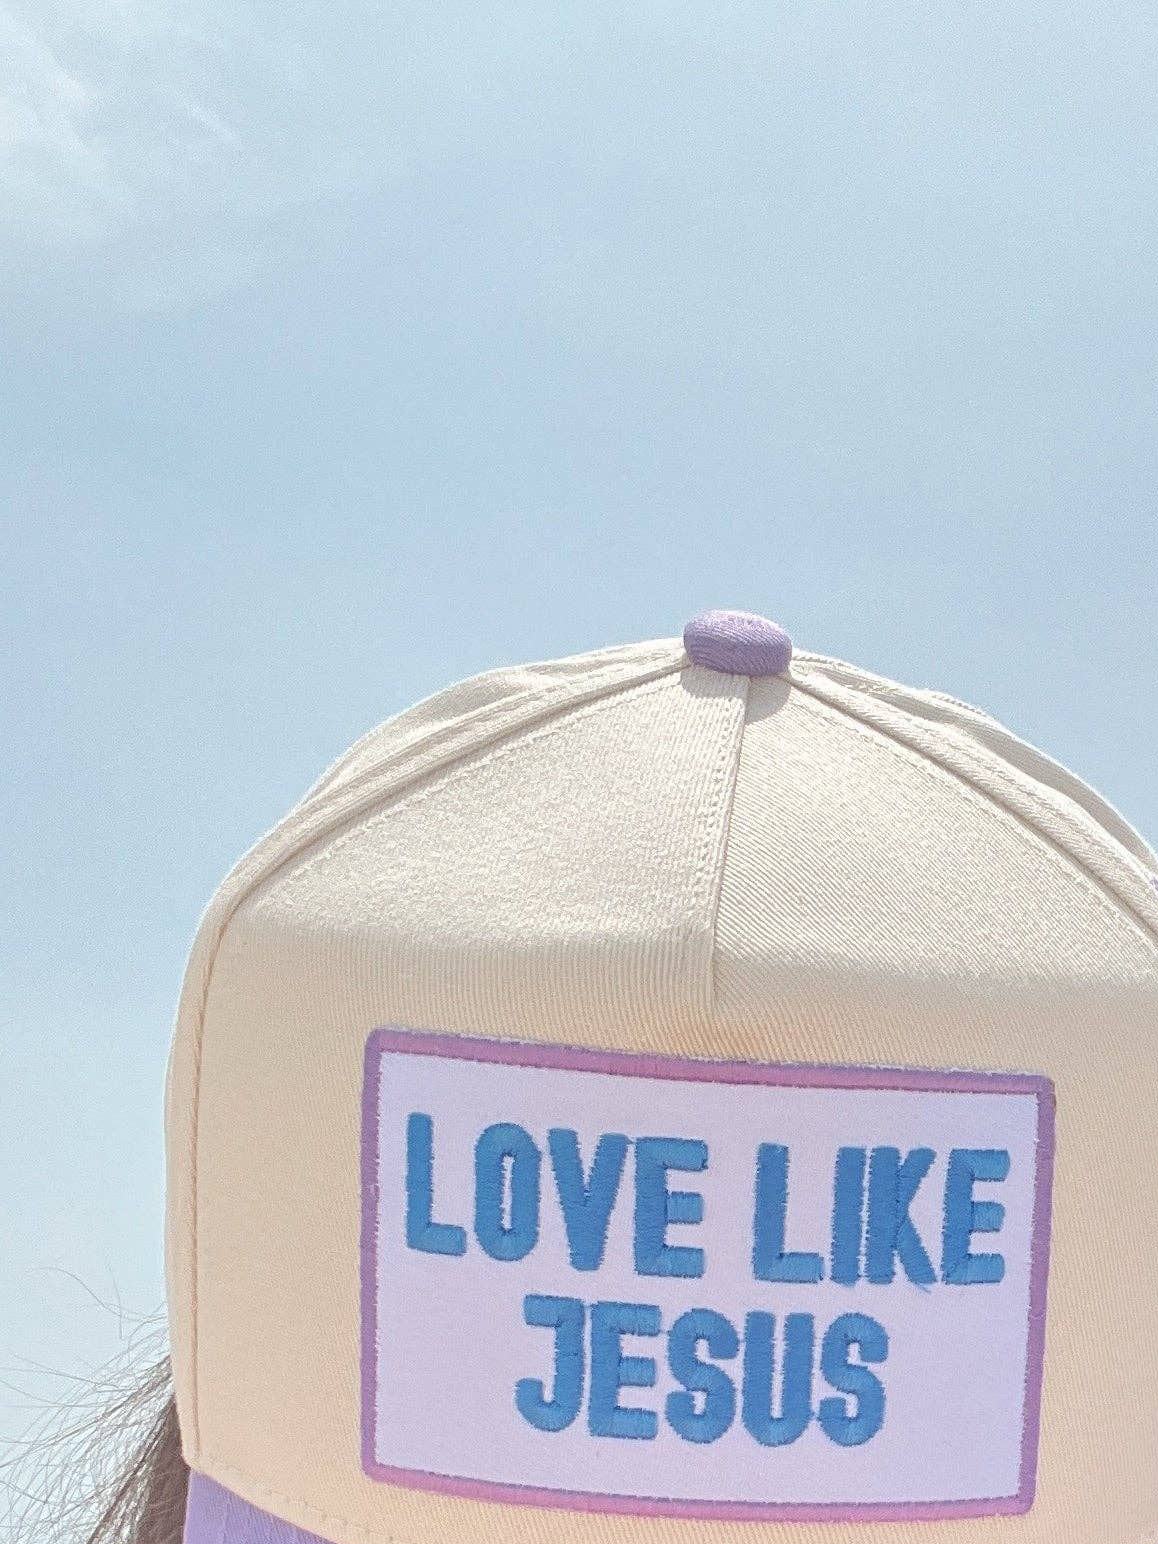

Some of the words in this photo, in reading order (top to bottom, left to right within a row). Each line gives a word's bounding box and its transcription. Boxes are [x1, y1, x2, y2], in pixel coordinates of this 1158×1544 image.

[405, 1113, 708, 1278] LOVE
[753, 1142, 1010, 1289] LIKE
[514, 1294, 889, 1447] JESUS
